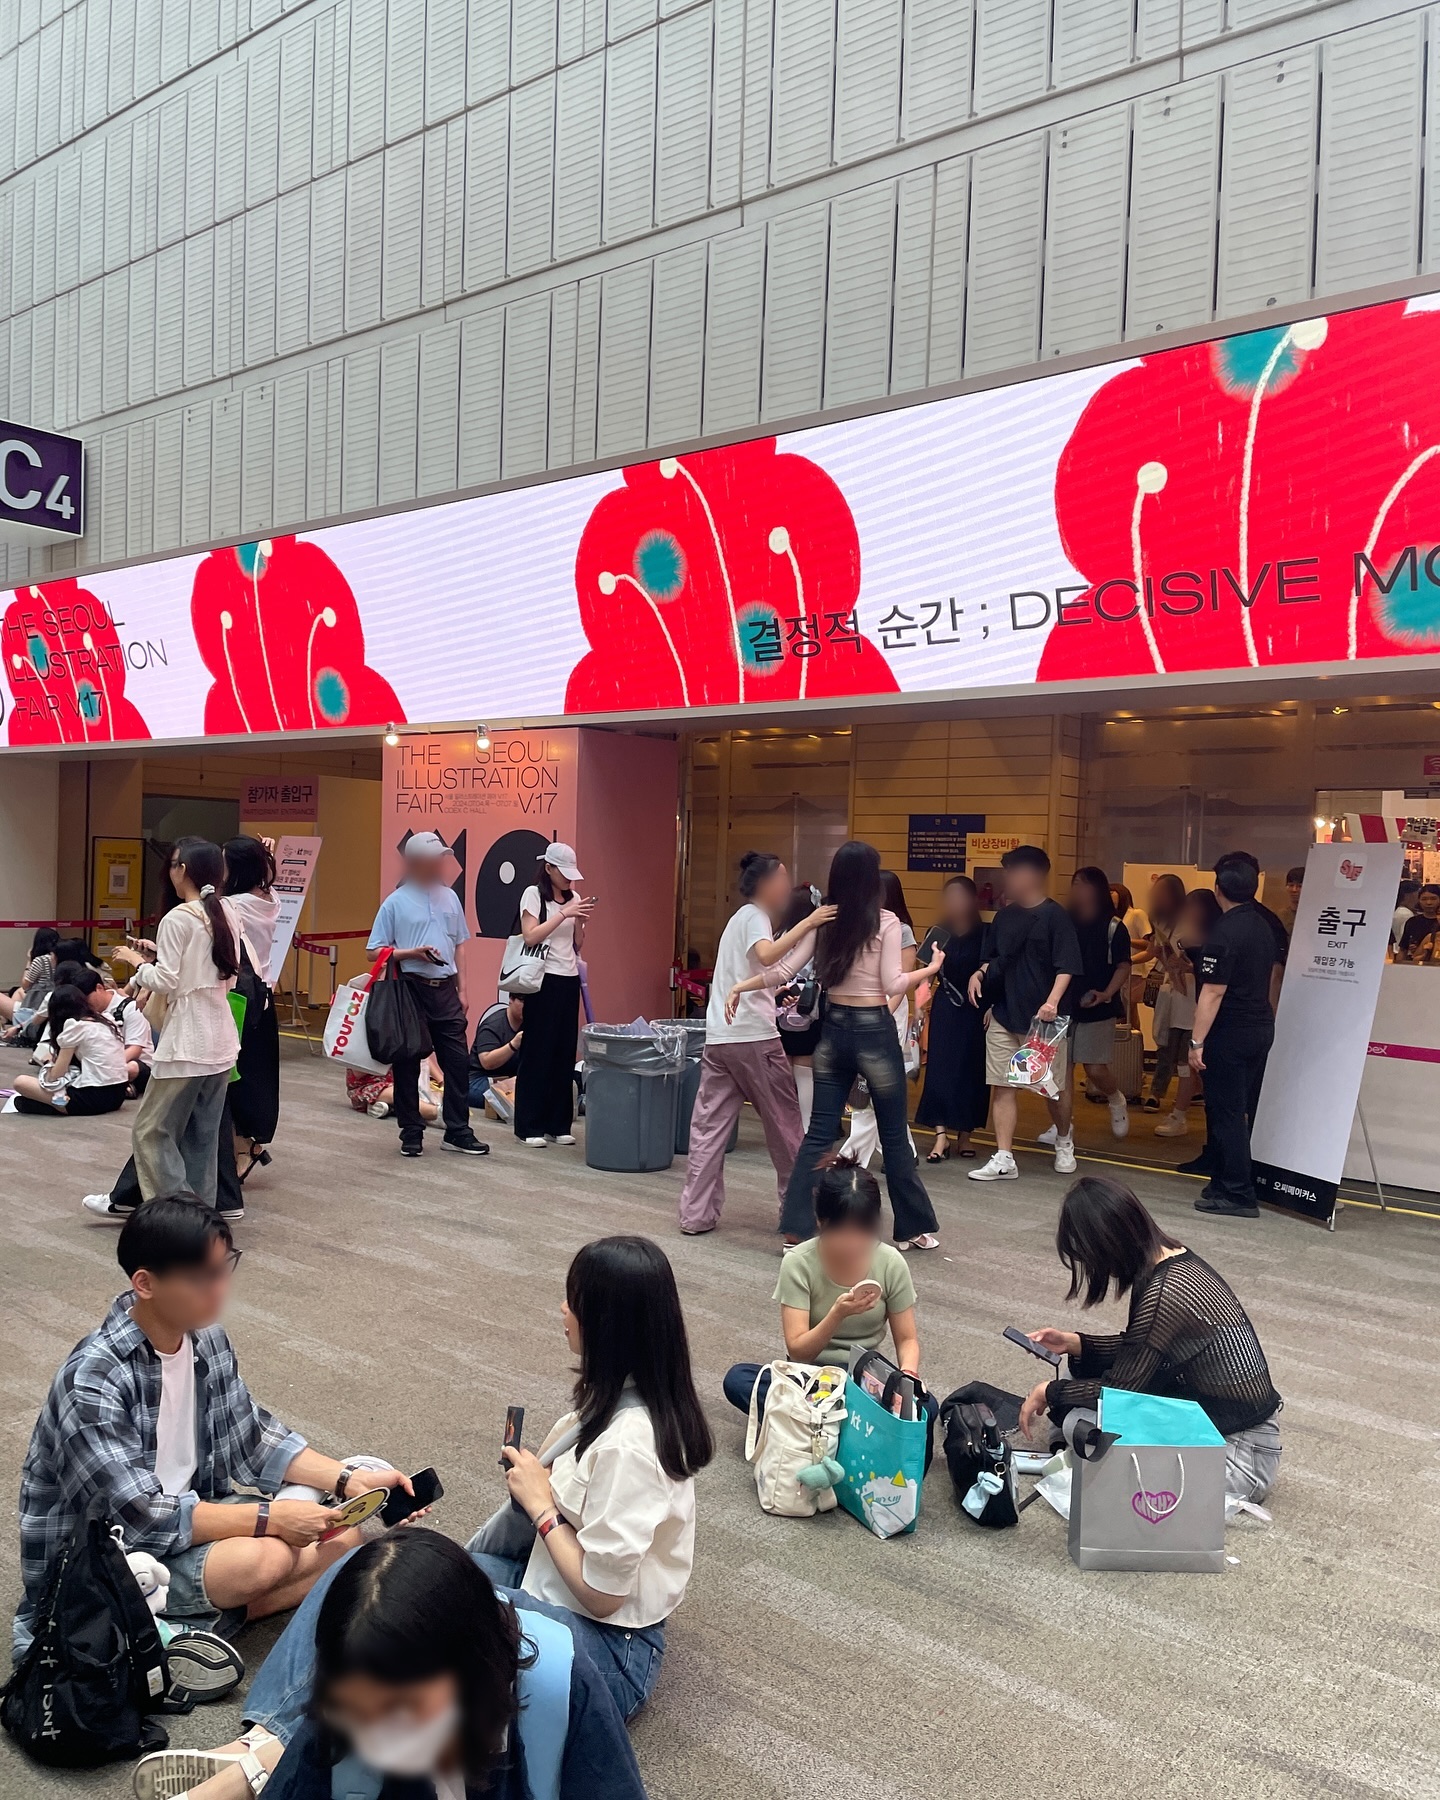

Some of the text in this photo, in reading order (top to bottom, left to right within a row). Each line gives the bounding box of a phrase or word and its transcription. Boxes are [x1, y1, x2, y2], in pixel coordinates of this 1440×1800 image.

[0, 439, 76, 520] C4
[0, 600, 126, 643] THE SEOUL
[747, 609, 864, 663] 결정적
[877, 596, 965, 650] 순간
[1010, 557, 1321, 631] DECISIVE
[4, 638, 169, 683] ILLUSTRATION
[14, 690, 105, 721] FAIR V.17
[396, 740, 561, 766] THE SEOUL
[396, 766, 559, 790] ILLUSTRATION
[247, 785, 313, 803] 참가자 출입구
[396, 792, 559, 814] FAIR V.17
[1318, 906, 1367, 937] 출구
[520, 942, 550, 960] NIK
[1327, 940, 1348, 949] EXIT
[1313, 955, 1355, 969] 재입장 가능
